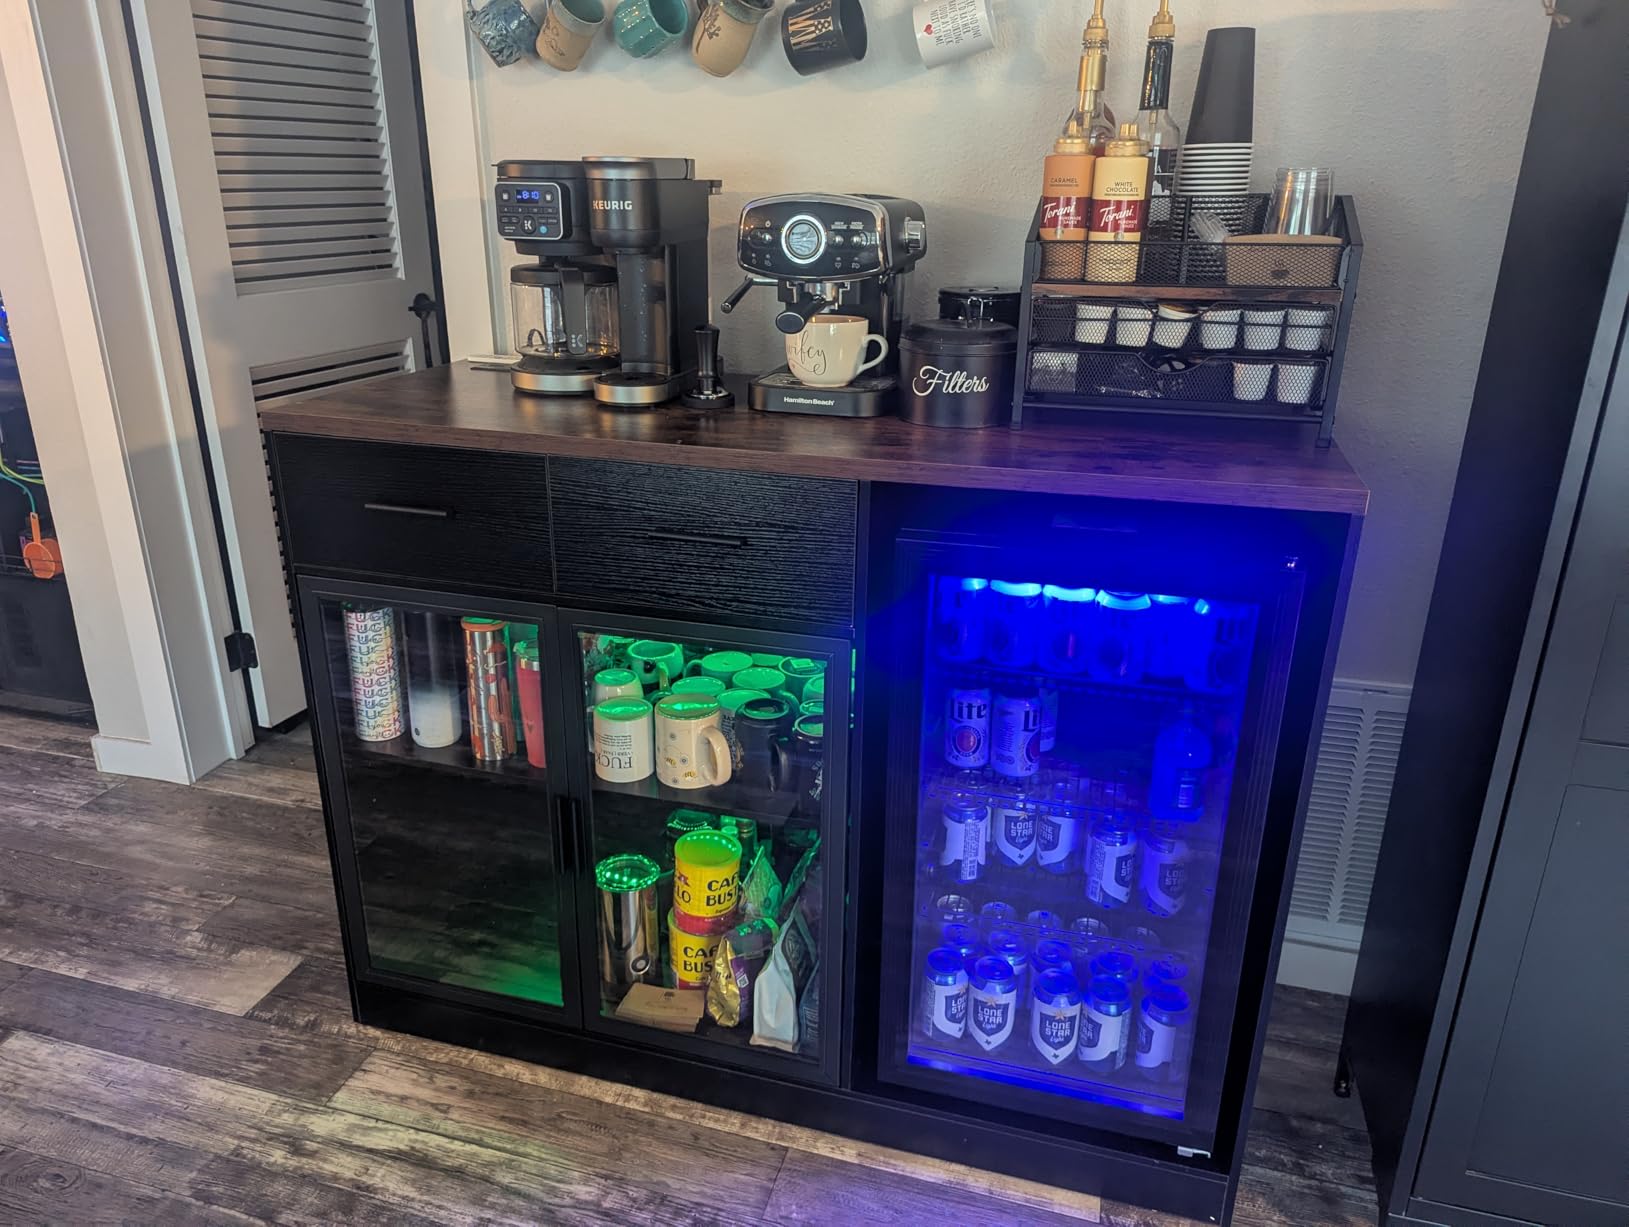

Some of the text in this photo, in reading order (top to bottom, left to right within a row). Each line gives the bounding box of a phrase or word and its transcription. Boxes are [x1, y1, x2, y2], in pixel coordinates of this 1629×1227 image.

[959, 12, 971, 35] RATHER
[943, 28, 954, 46] FUCK
[971, 25, 982, 39] ONE
[592, 200, 633, 211] KEURIG
[1043, 202, 1077, 223] Torani
[1100, 205, 1135, 227] Torani
[913, 365, 990, 396] Filters
[783, 396, 835, 407] Hamilton Beach
[950, 698, 987, 723] Lite
[1022, 710, 1041, 732] Li
[595, 752, 633, 769] FUCK
[1011, 821, 1033, 830] LONE
[1010, 829, 1033, 837] STAR
[707, 872, 739, 892] CAF
[683, 945, 719, 959] CAF
[978, 1005, 1003, 1017] LONE
[978, 1012, 1003, 1024] STAR
[1046, 1019, 1071, 1030] LONE
[1046, 1027, 1071, 1037] STAR
